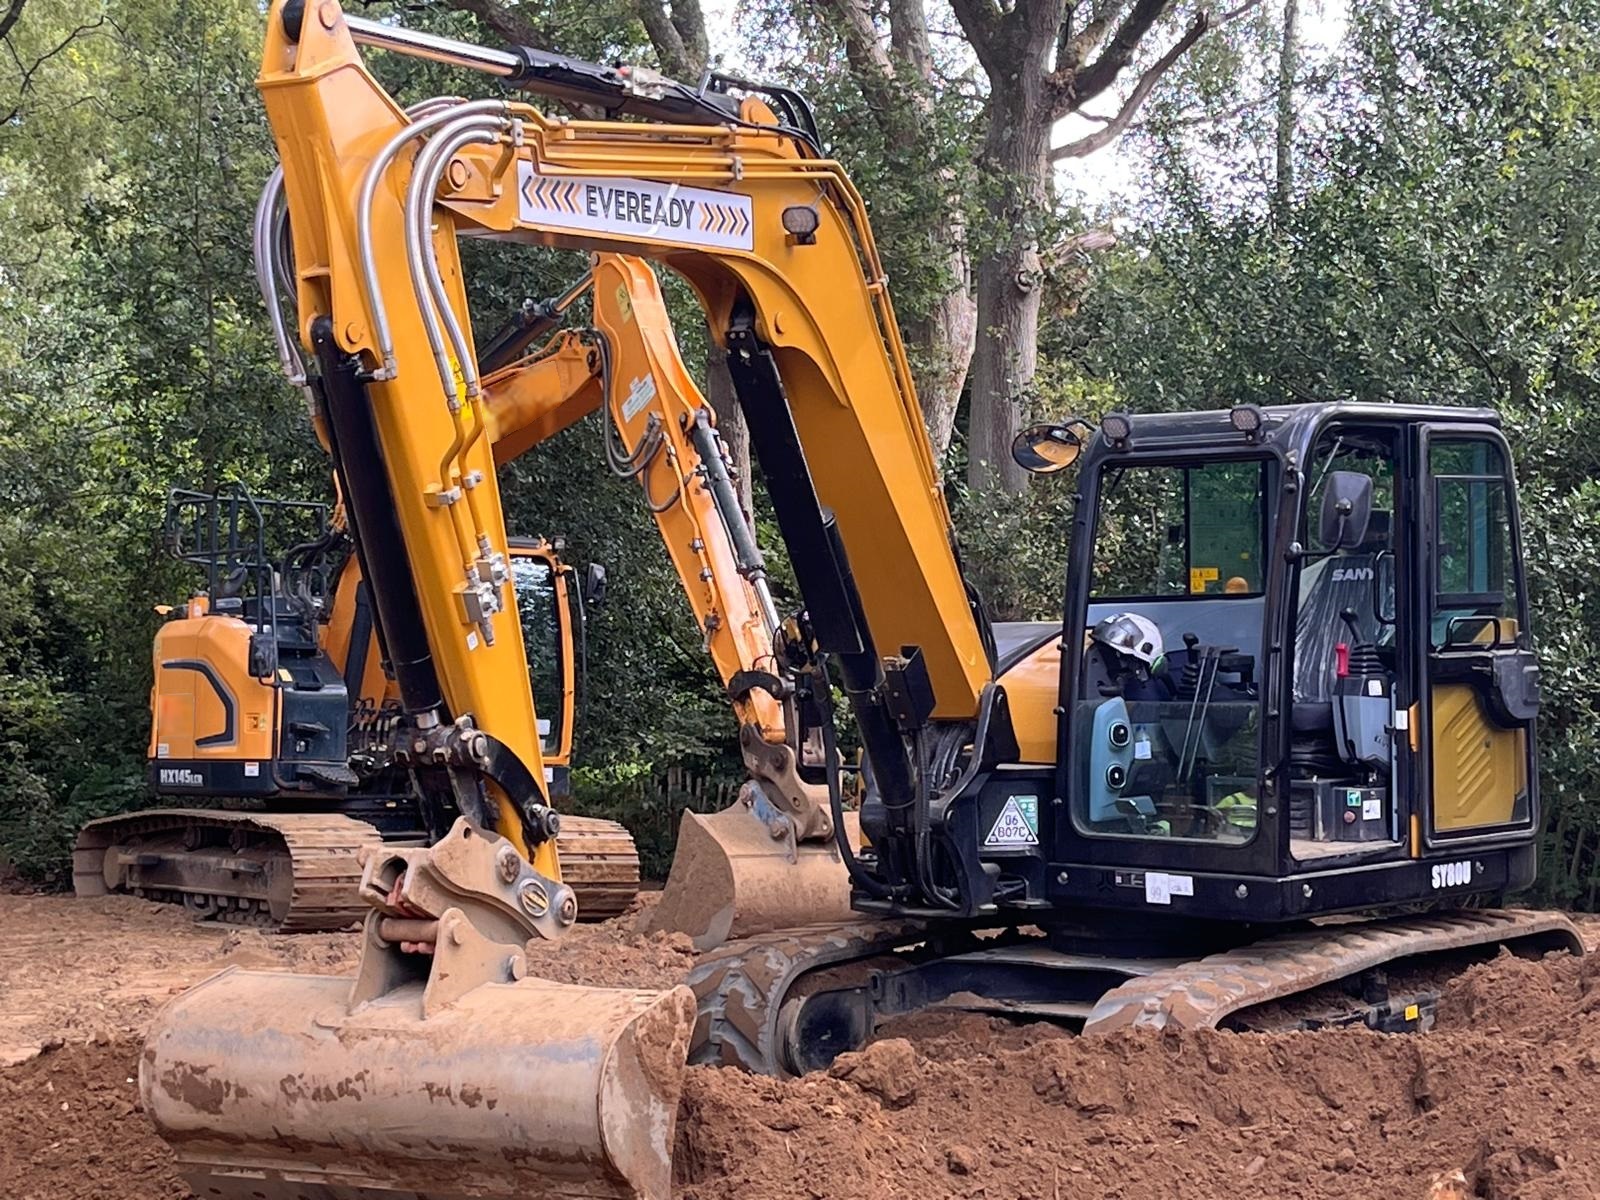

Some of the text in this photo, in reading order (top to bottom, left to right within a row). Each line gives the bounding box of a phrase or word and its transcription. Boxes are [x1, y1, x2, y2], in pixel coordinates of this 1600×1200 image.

[586, 184, 696, 230] EVEREADY
[1005, 815, 1019, 826] 06
[1431, 860, 1472, 889] SY80U
